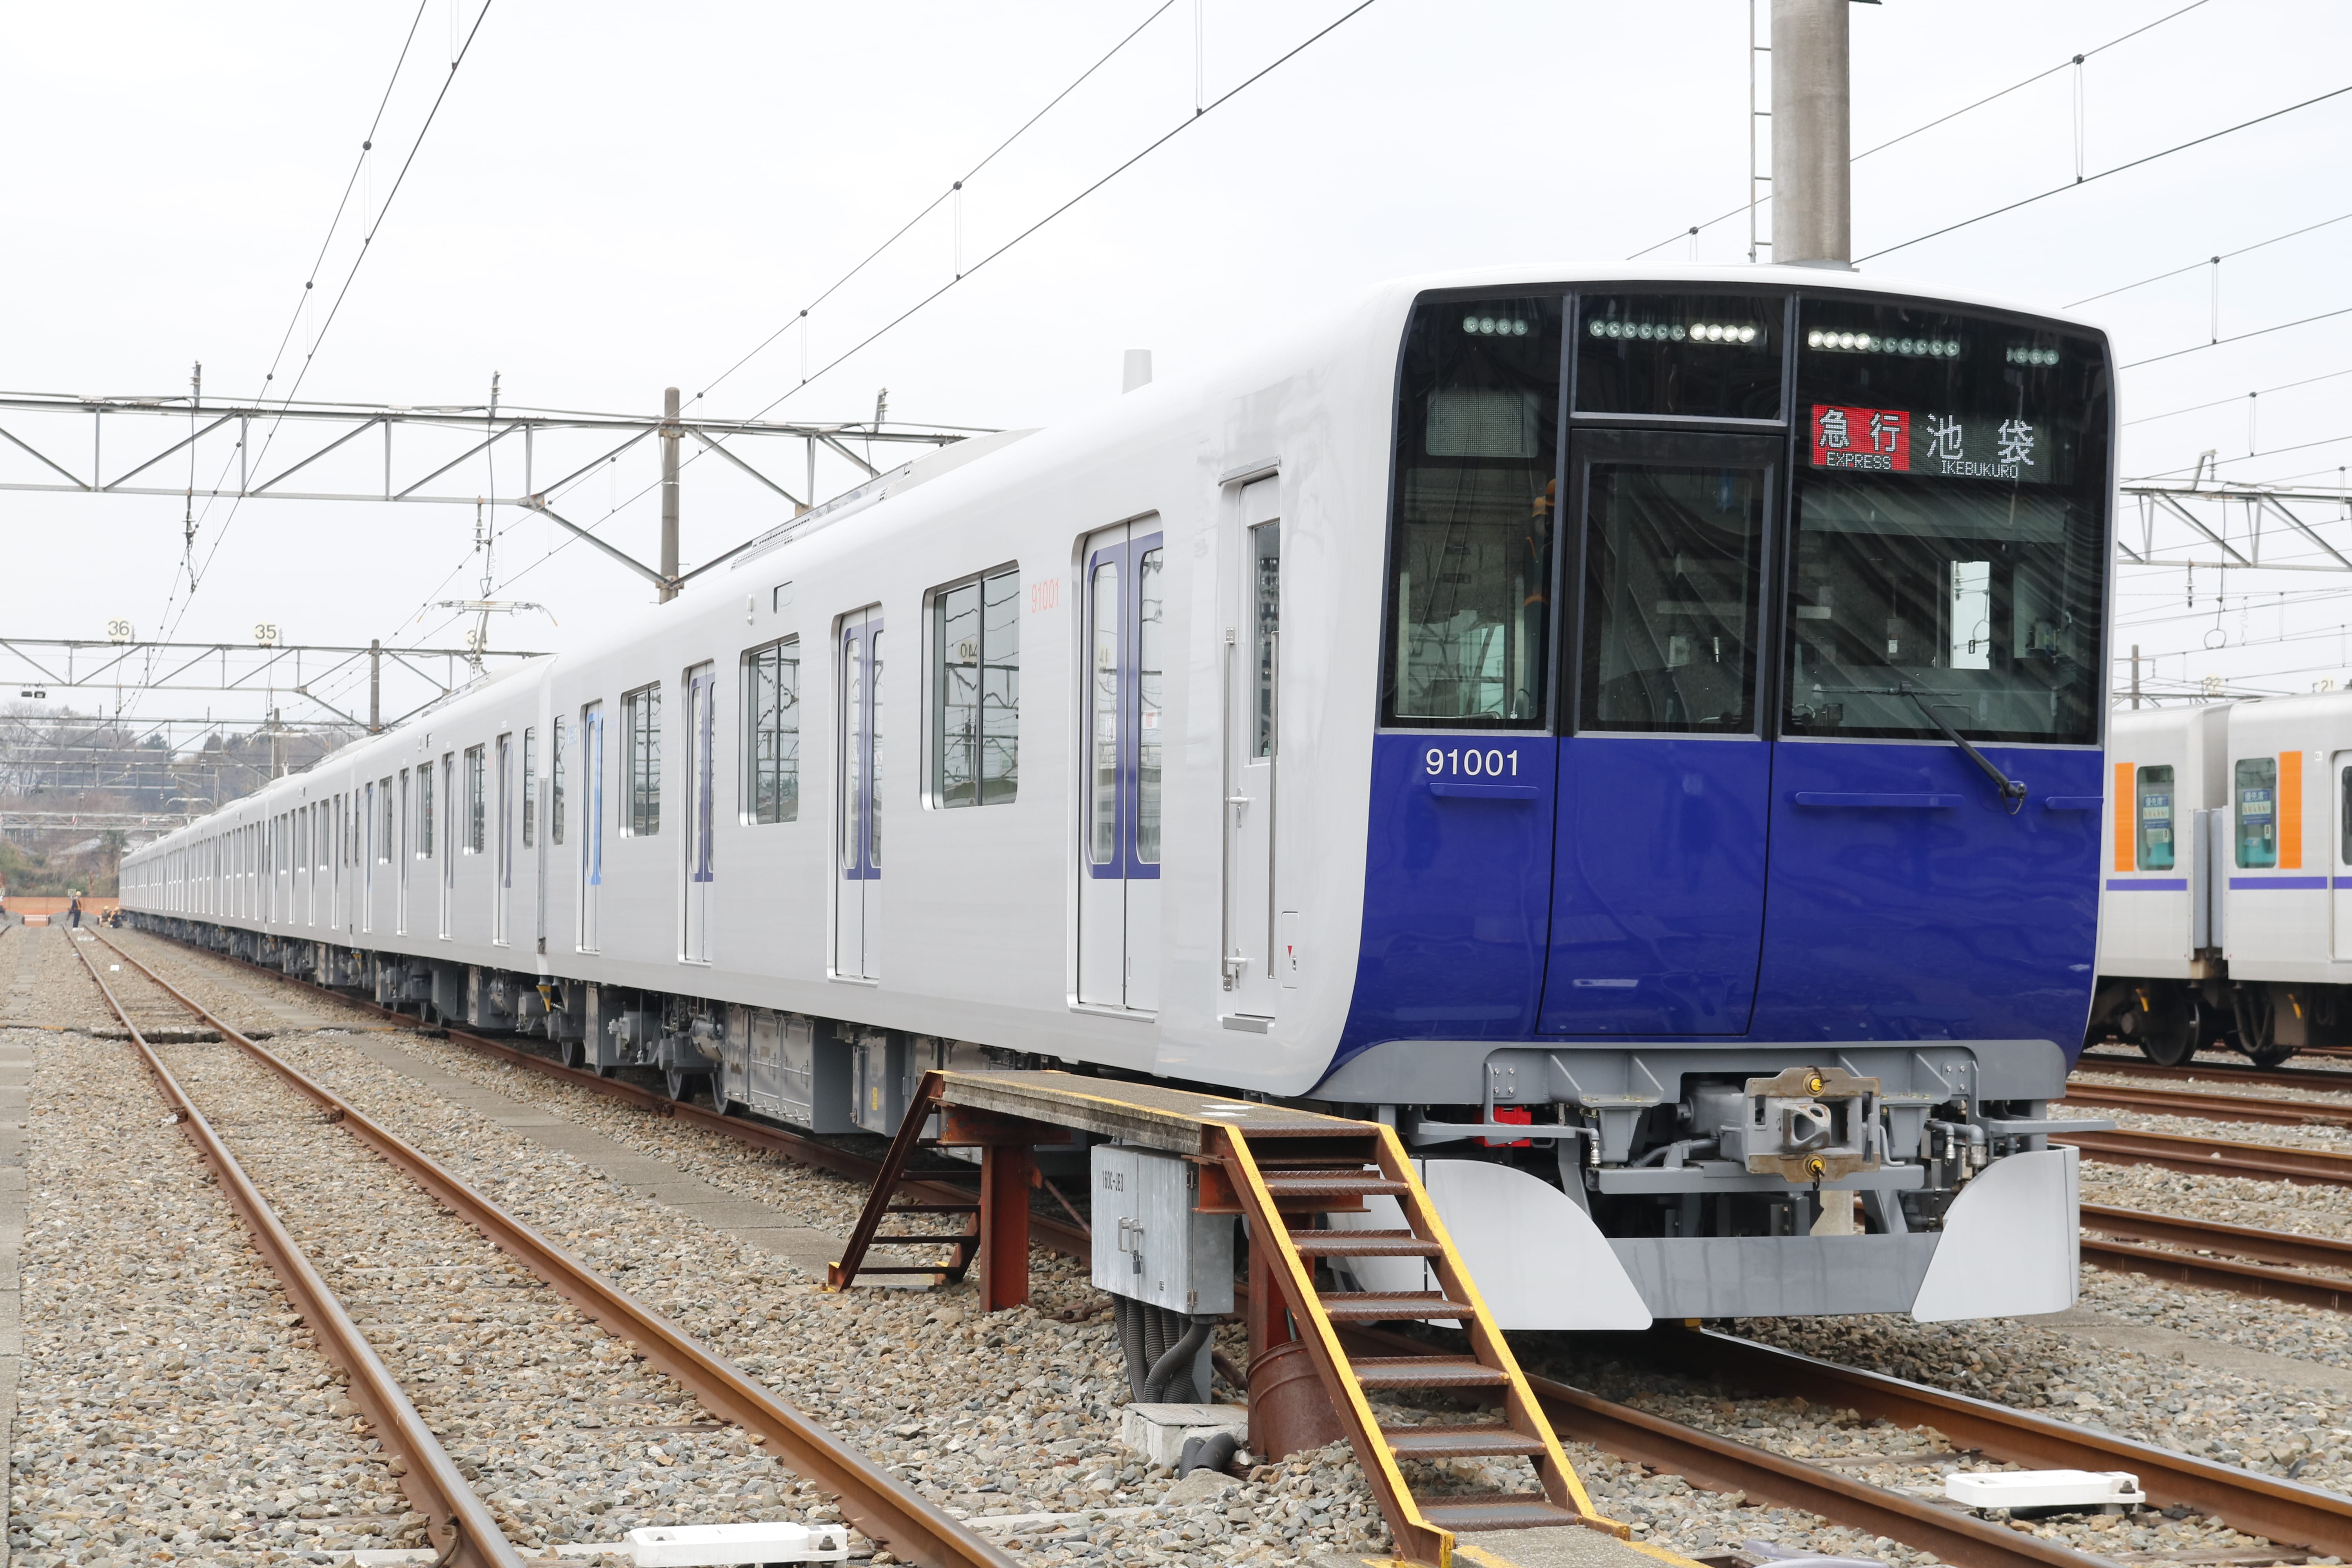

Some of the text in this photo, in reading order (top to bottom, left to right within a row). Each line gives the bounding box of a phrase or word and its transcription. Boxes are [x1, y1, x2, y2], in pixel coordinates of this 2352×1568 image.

[1819, 408, 2034, 465] 急行 池袋
[1826, 452, 2019, 479] EXPRESS IKEBUKURO
[1031, 577, 1059, 613] 91001
[107, 620, 130, 636] 36
[254, 624, 276, 640] 35
[1425, 748, 1518, 776] 91001
[1102, 1170, 1124, 1192] 160C-JB3
